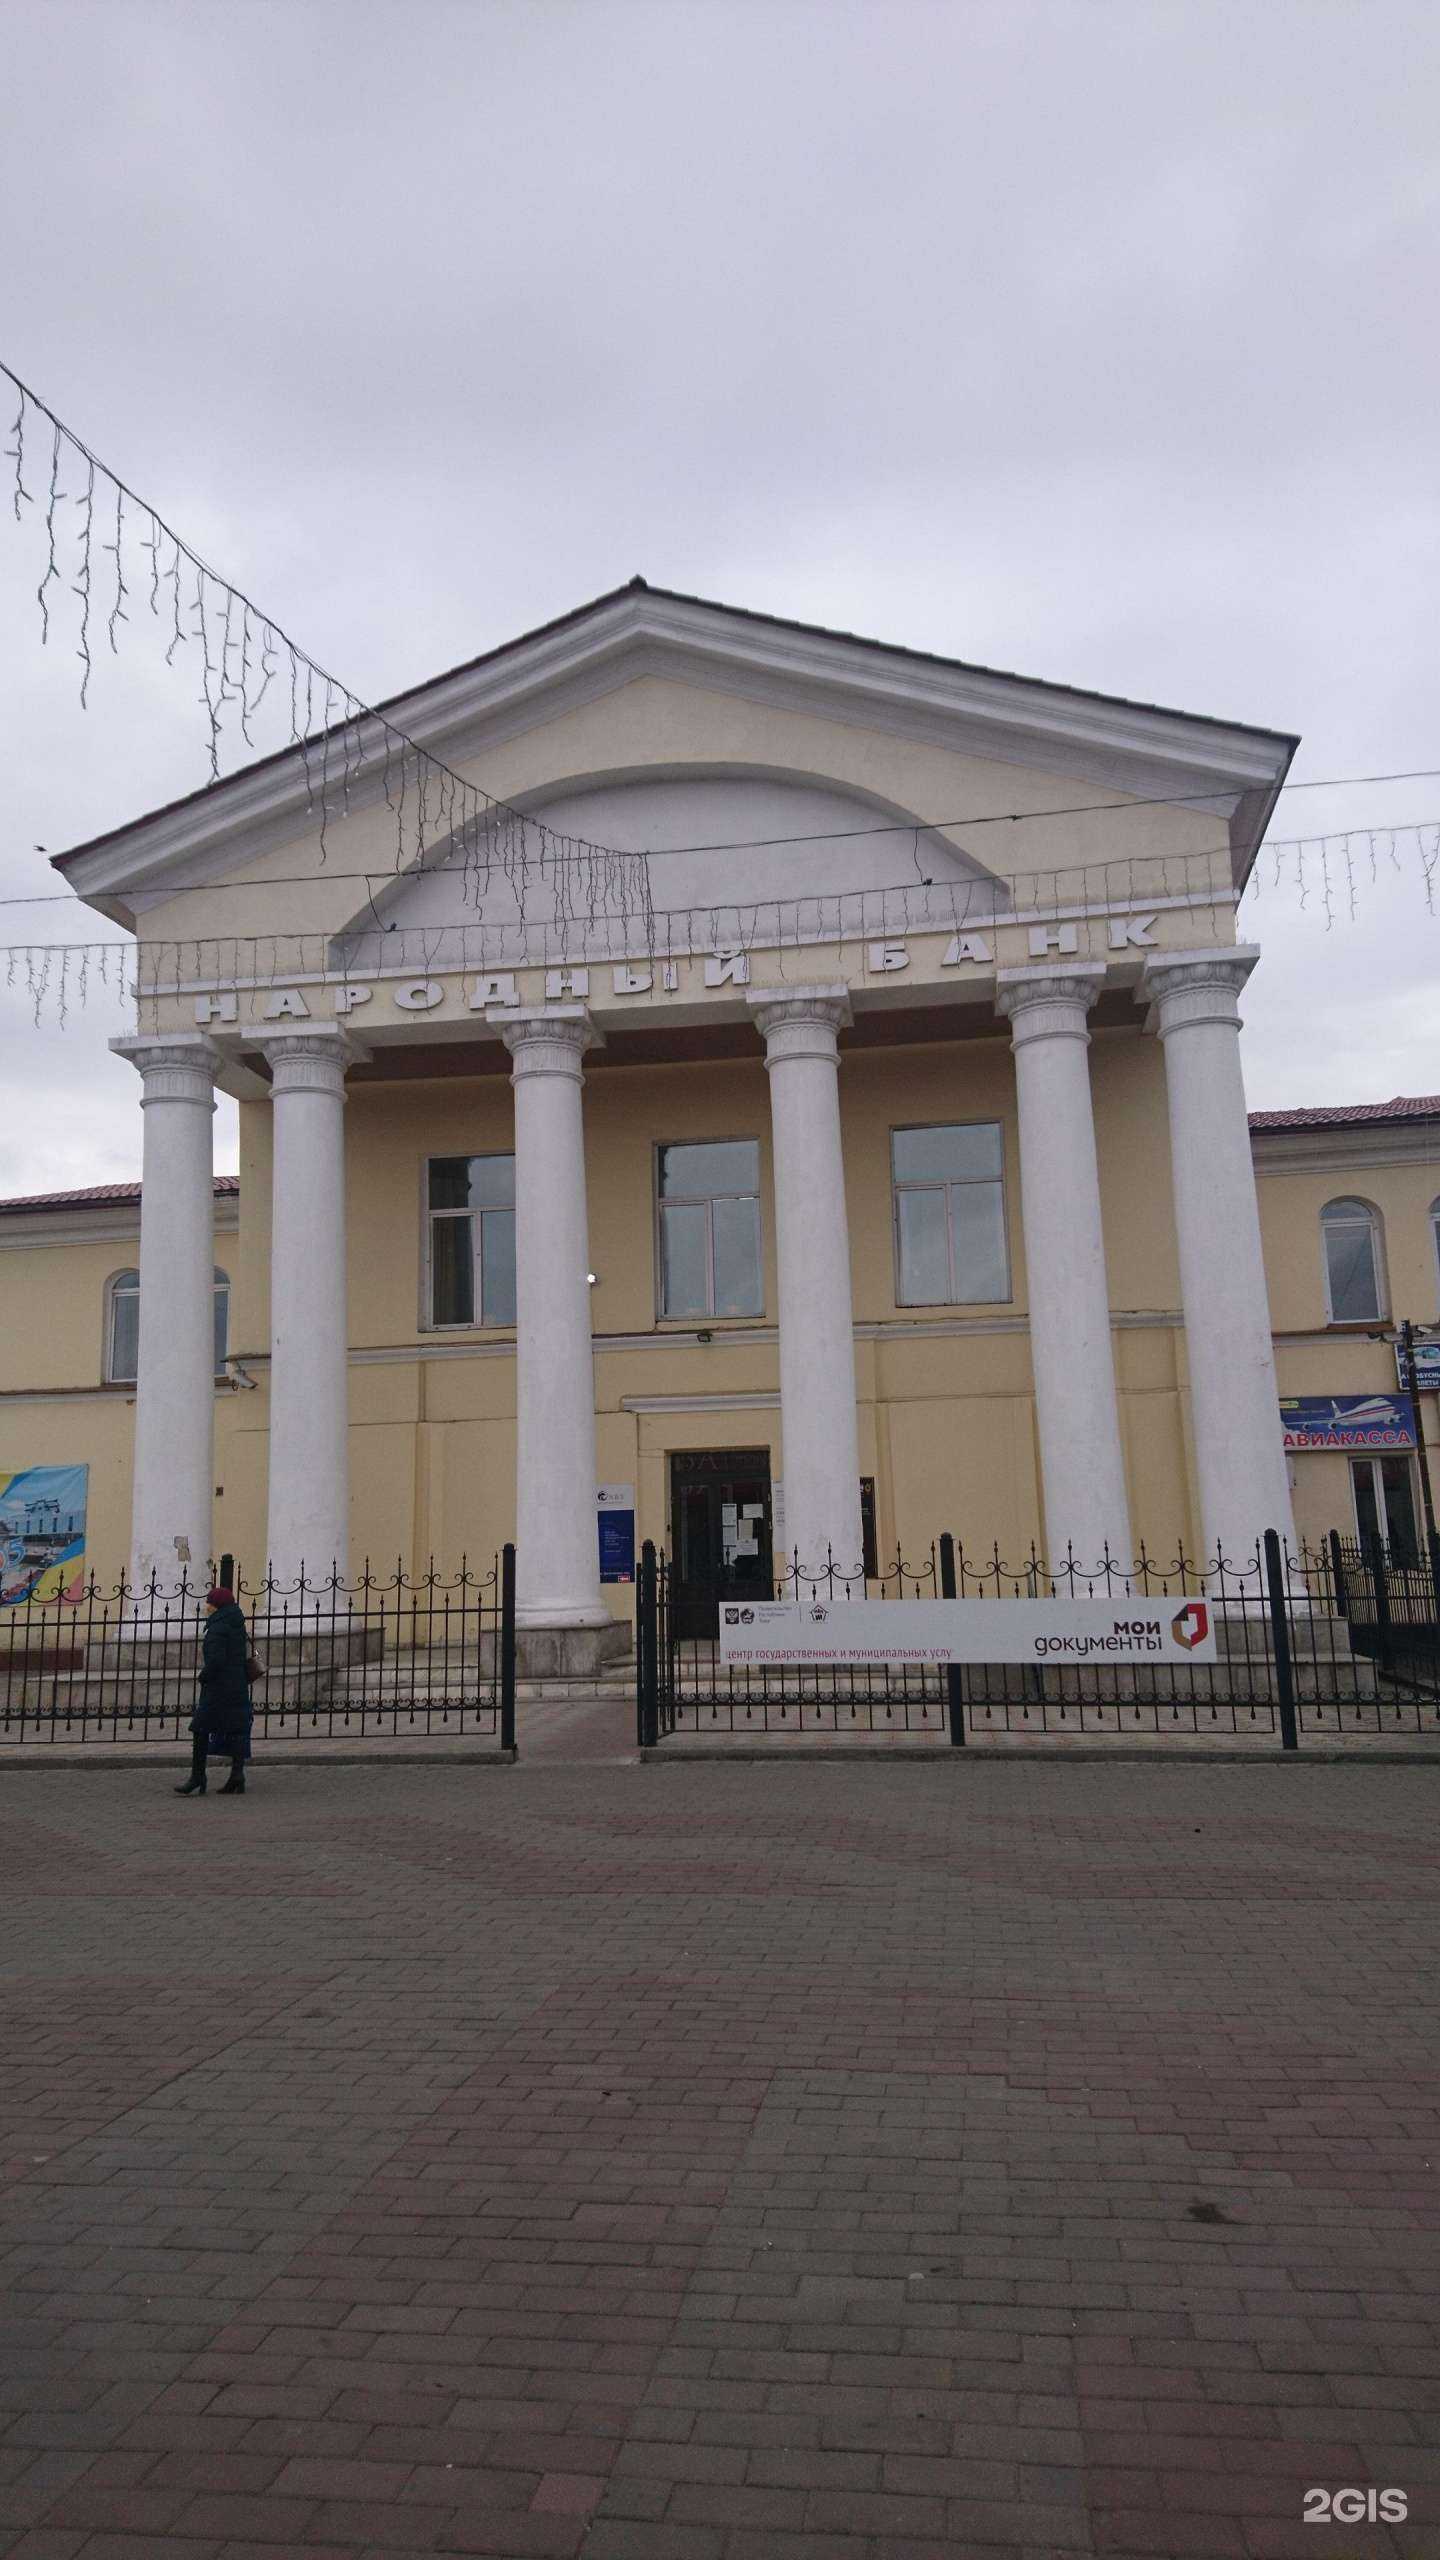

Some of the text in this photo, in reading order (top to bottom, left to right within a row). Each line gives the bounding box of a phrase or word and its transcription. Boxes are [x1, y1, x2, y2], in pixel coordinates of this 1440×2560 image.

[195, 915, 1160, 1024] НАРОДНЫЙ БАНК
[1283, 1430, 1411, 1447] АВИАКАССА
[755, 1647, 837, 1661] государственных
[840, 1649, 847, 1659] и
[849, 1647, 927, 1661] муниципальных
[1034, 1636, 1162, 1656] документы
